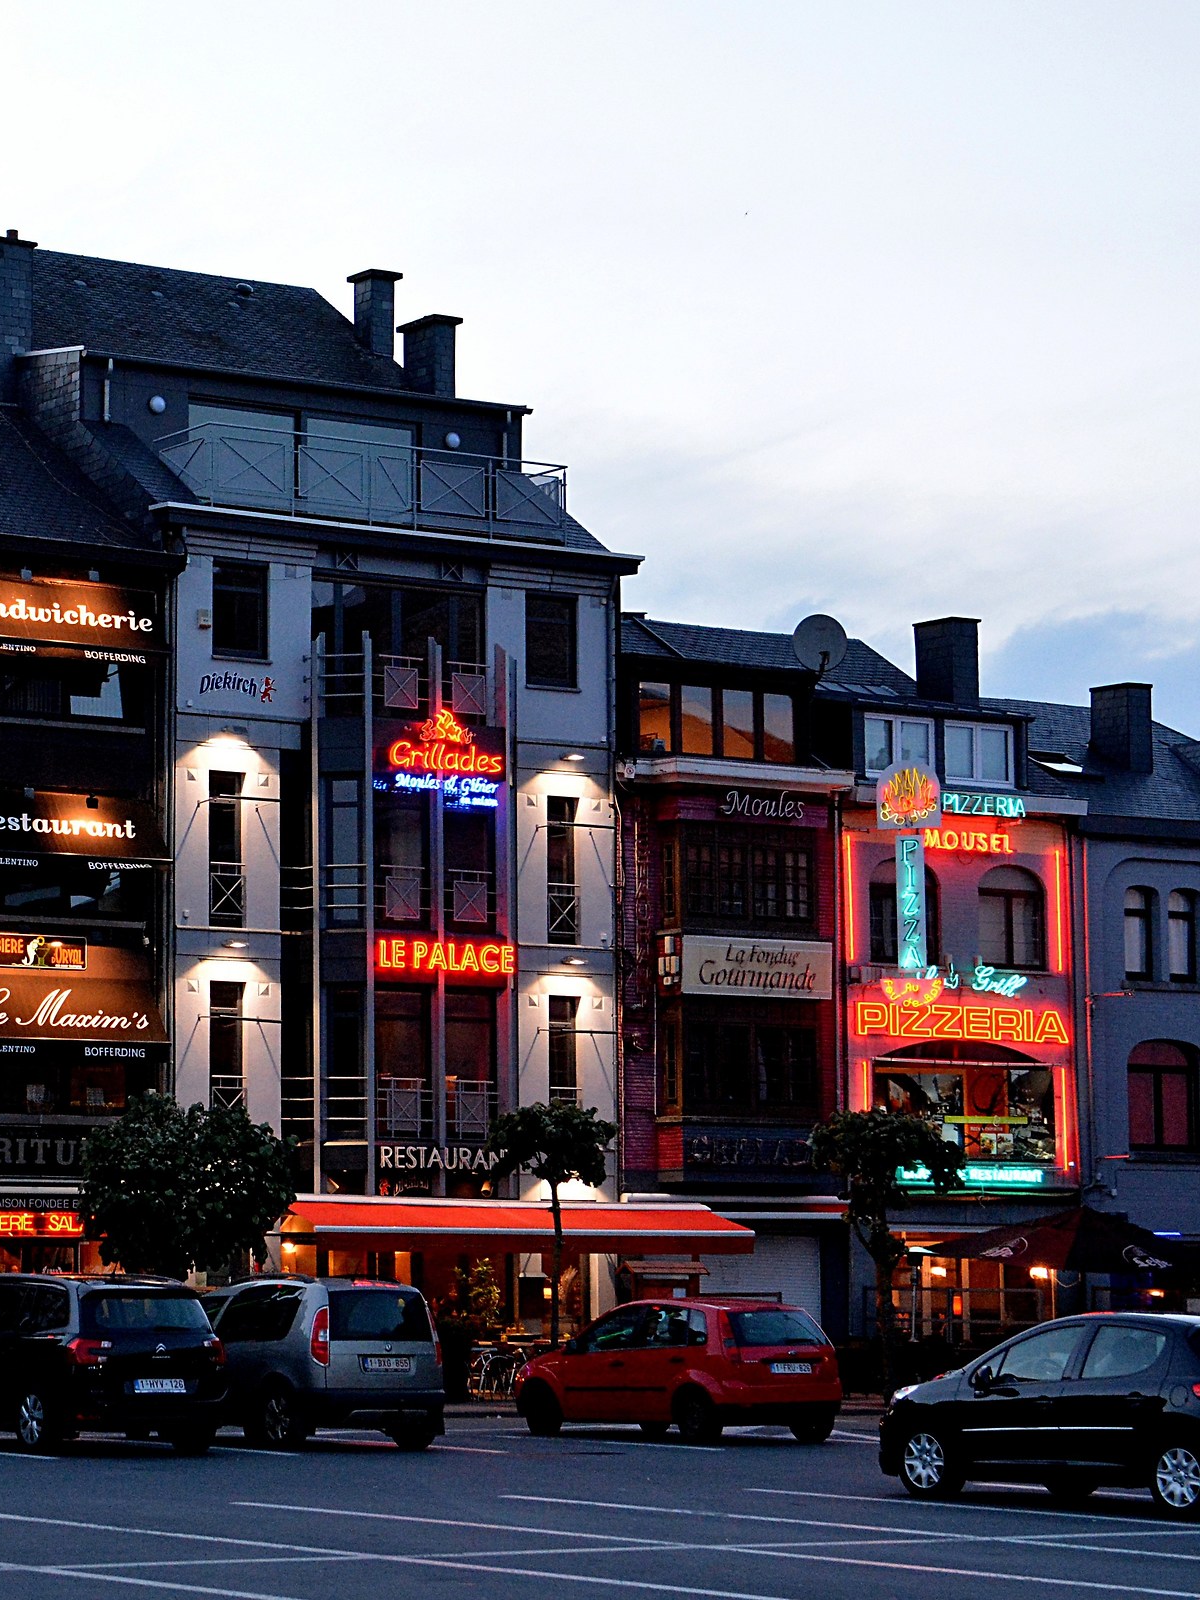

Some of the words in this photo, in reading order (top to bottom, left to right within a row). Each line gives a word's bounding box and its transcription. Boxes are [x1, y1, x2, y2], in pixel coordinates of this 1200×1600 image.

[84, 650, 146, 664] BOFFERDING
[200, 671, 257, 697] Diekirch
[390, 741, 502, 772] Grillades
[721, 790, 805, 819] Moules
[943, 793, 1026, 818] PIZZERIA
[924, 828, 1014, 853] MOUSEL
[88, 861, 152, 870] BOFFERDING
[900, 838, 925, 970] PIZZA
[379, 940, 405, 968] LE
[413, 941, 514, 973] PALACE
[725, 943, 745, 967] La
[699, 960, 817, 994] Gourmande
[971, 964, 1029, 998] Grill
[15, 988, 149, 1030] Maxim's
[855, 1001, 1070, 1044] PIZZERIA
[84, 1047, 146, 1058] BOFFERDING
[970, 1169, 1044, 1183] RESTAURANT
[29, 1199, 68, 1208] FONDEE
[49, 1215, 83, 1231] SAL
